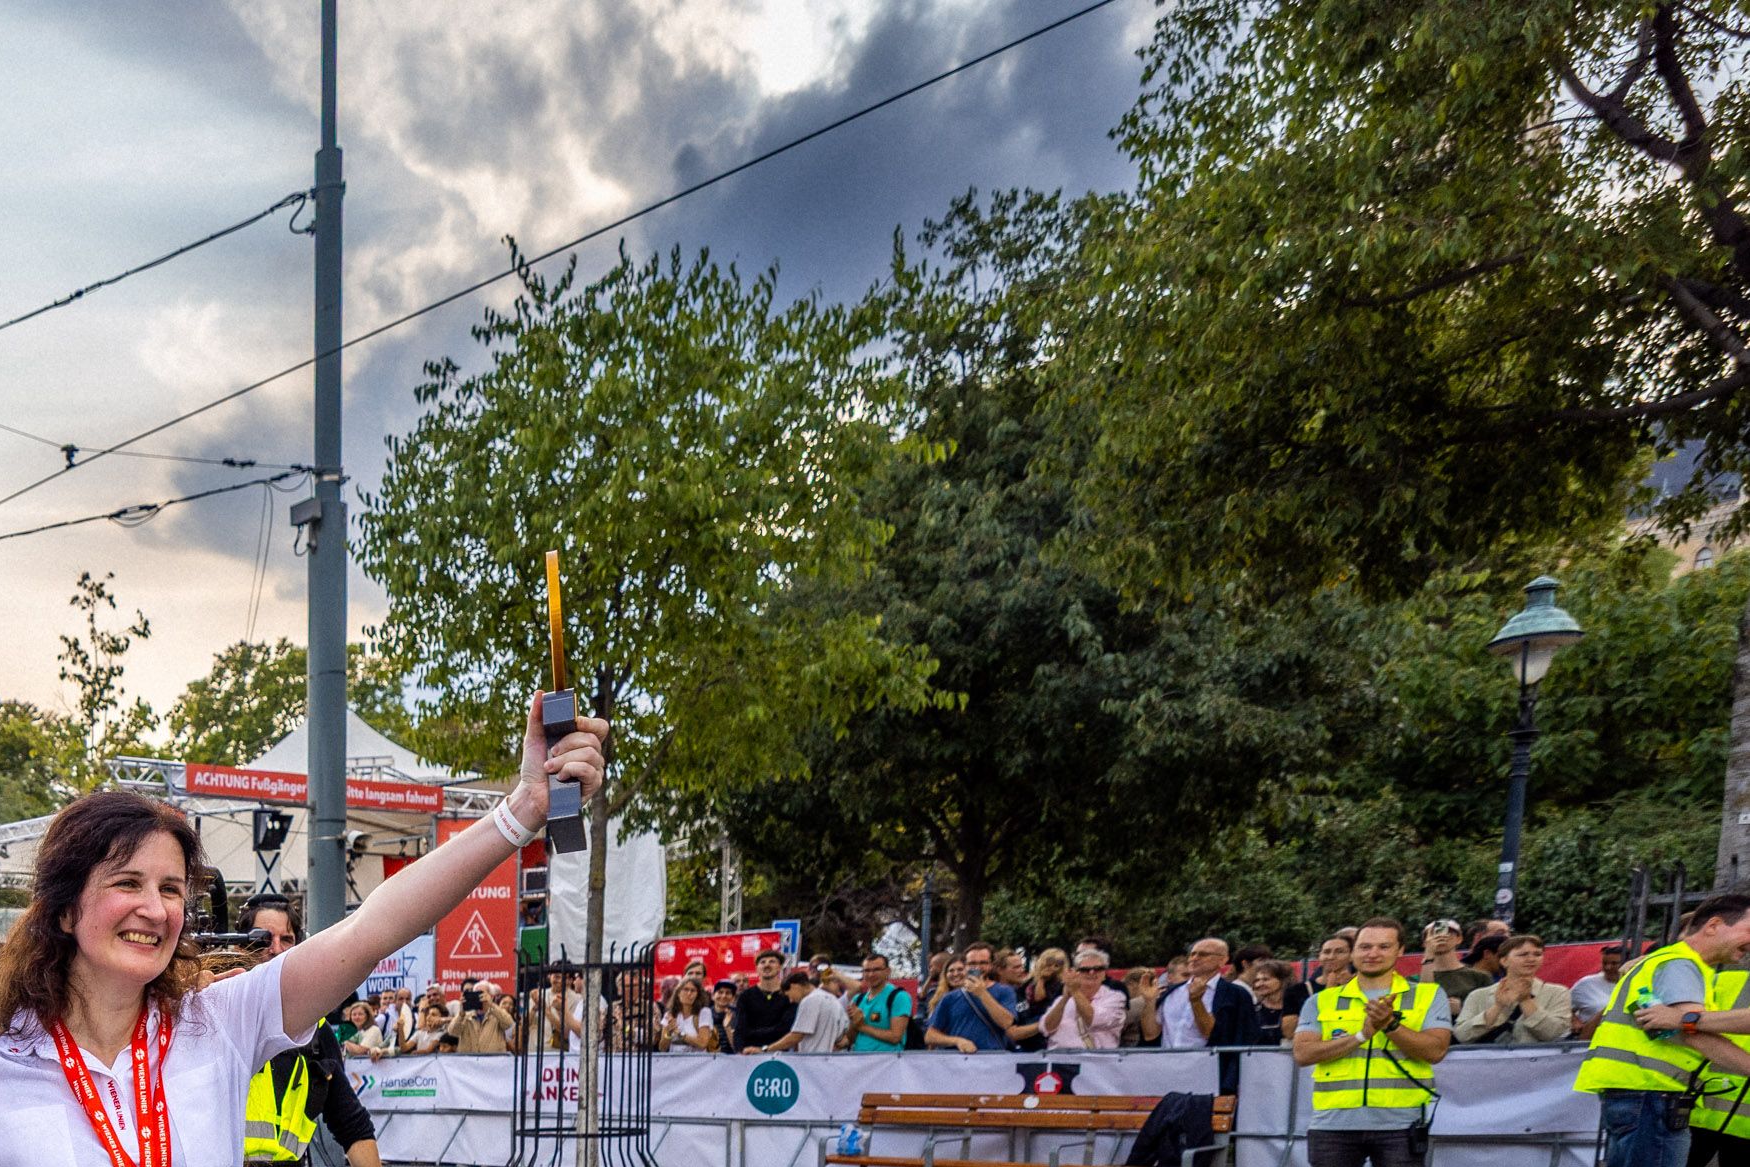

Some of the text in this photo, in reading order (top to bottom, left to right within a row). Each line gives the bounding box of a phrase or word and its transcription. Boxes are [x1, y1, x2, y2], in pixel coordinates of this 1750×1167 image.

[194, 772, 250, 789] ACHTUNG
[250, 776, 307, 796] Fußgänger
[365, 787, 404, 804] langsam
[406, 789, 438, 805] fahren!
[466, 886, 511, 899] TUNG!
[367, 976, 403, 993] WORLD
[442, 969, 509, 981] Bitte langsam
[80, 1077, 95, 1100] LINIEN
[138, 1062, 148, 1114] WIENER LINIEN
[381, 1075, 438, 1088] HanseCom
[754, 1077, 792, 1098] GIRO
[533, 1086, 580, 1102] ANKE
[107, 1080, 126, 1131] WIENER LINIEN
[102, 1123, 117, 1149] WIENER
[157, 1114, 168, 1167] WIENER LINIEN
